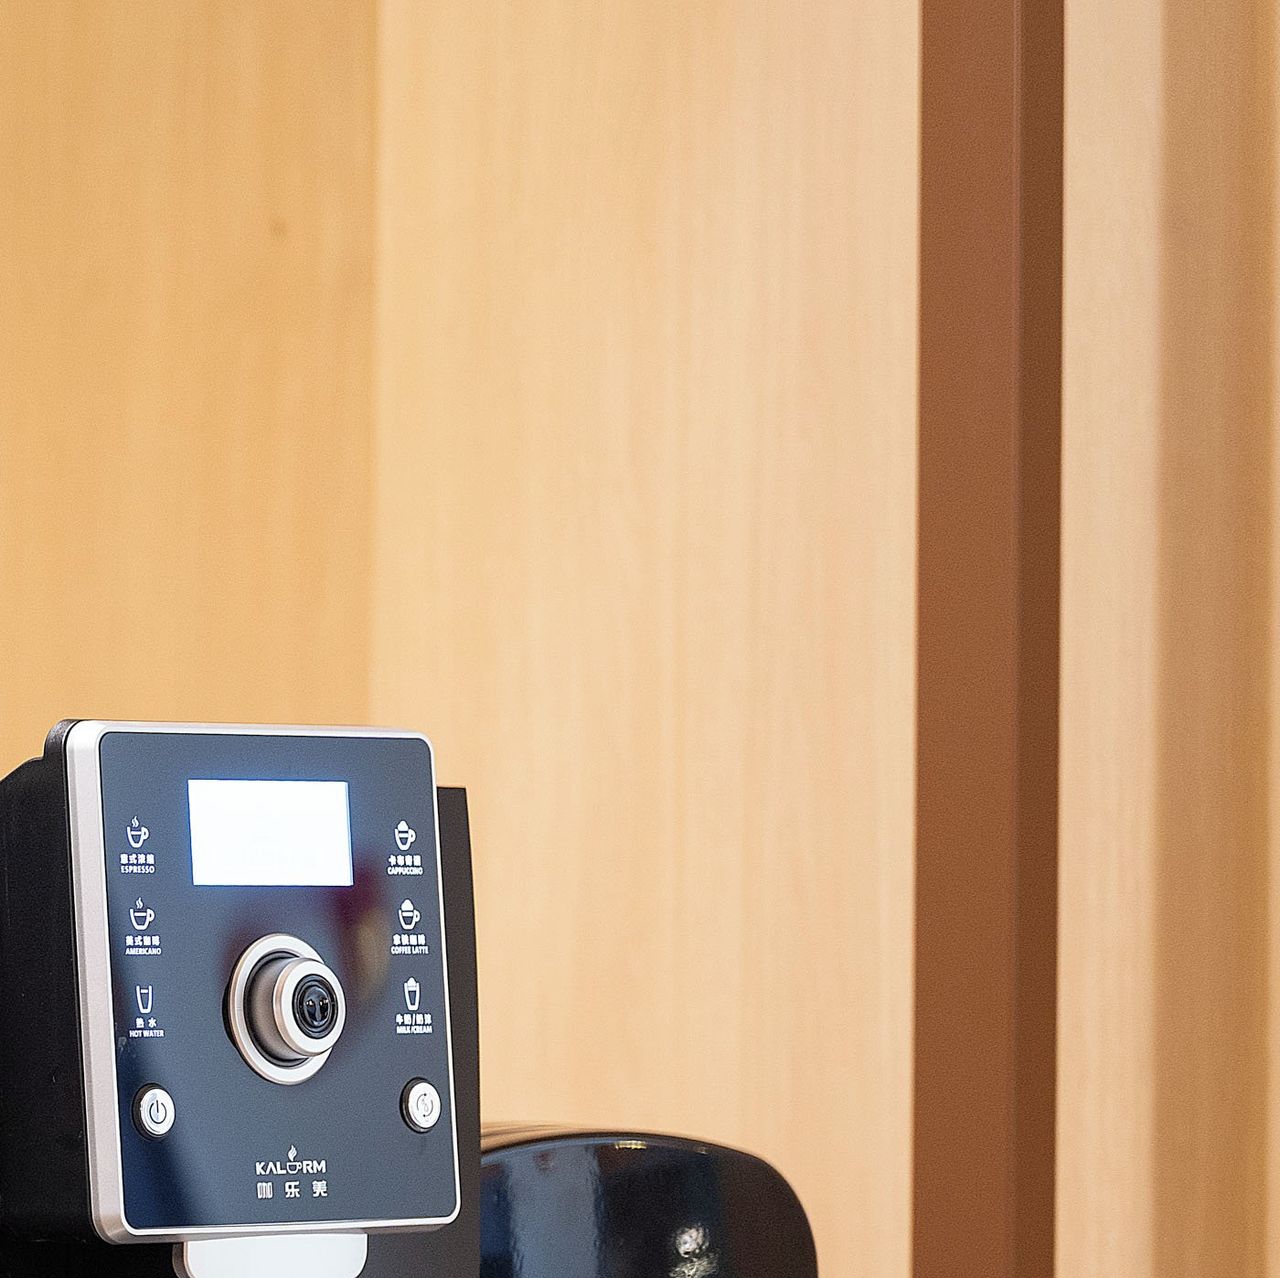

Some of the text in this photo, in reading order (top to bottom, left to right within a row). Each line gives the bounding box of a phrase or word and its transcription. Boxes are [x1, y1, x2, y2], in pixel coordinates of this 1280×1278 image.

[120, 865, 155, 874] ESPRESSO
[387, 866, 423, 875] CAPPUCCINO
[125, 947, 162, 955] AMERICANO
[390, 945, 429, 955] COFFEE LATTE
[129, 1029, 165, 1038] HOT WATER
